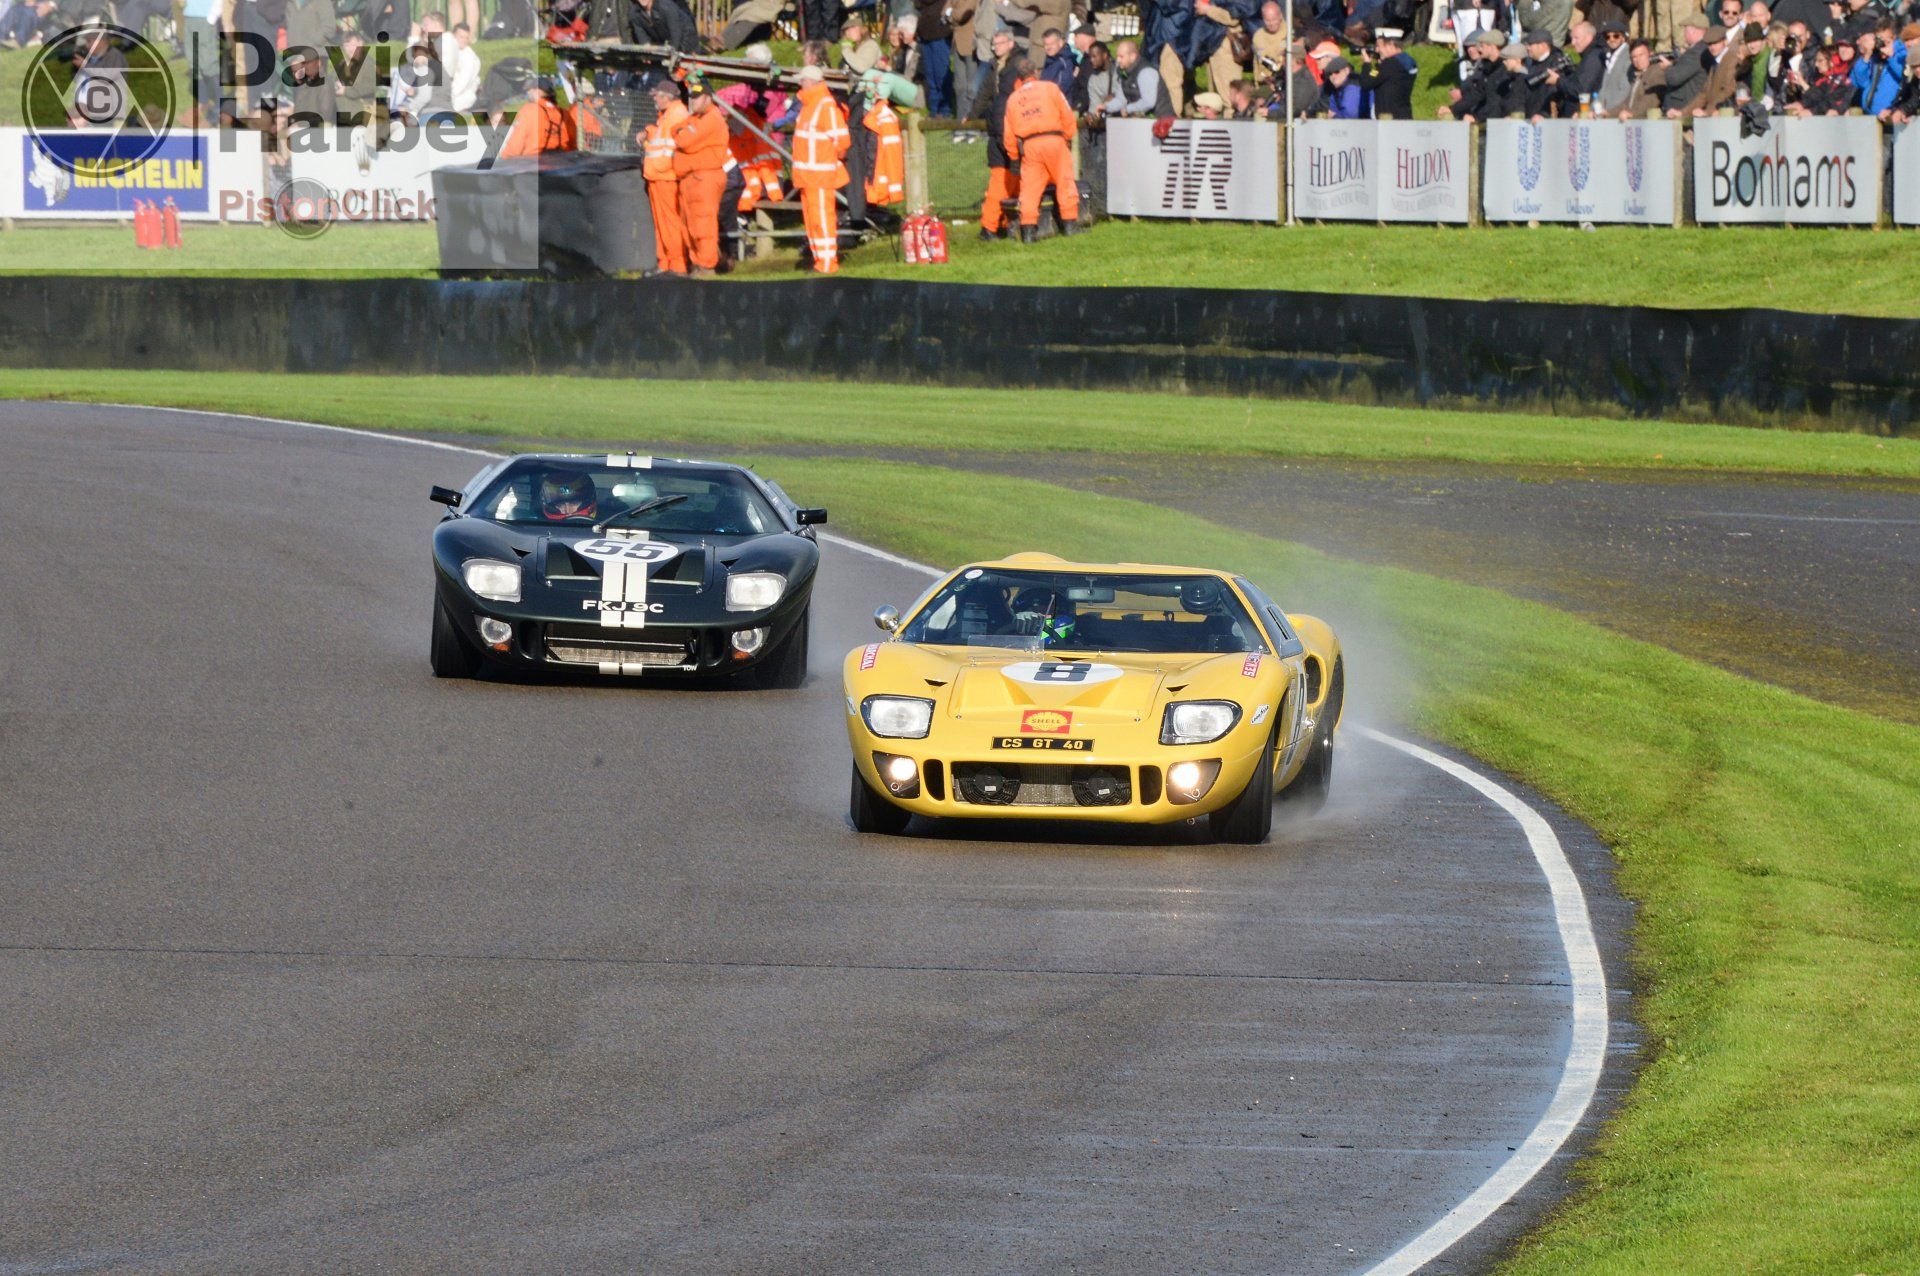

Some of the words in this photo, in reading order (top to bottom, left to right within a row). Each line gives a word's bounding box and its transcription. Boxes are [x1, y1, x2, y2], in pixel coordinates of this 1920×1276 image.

[74, 157, 203, 189] MICHELIN
[1712, 132, 1856, 208] Bonhams
[583, 539, 671, 560] 55
[582, 599, 627, 612] FKJ
[632, 602, 665, 613] 9C
[1034, 662, 1092, 681] 8
[1001, 738, 1023, 749] CS
[1032, 739, 1054, 749] GT
[1062, 740, 1084, 750] 40
